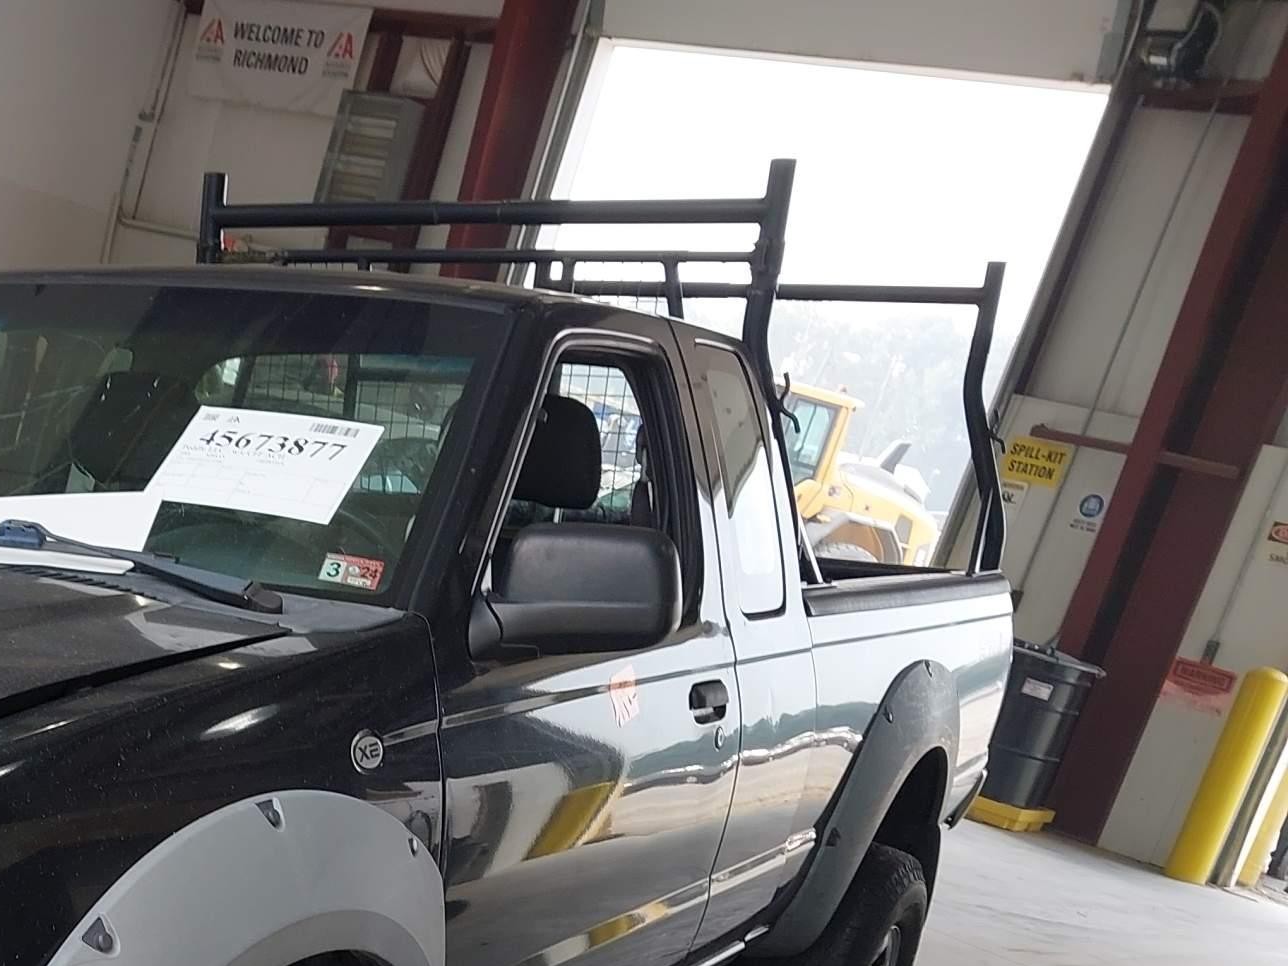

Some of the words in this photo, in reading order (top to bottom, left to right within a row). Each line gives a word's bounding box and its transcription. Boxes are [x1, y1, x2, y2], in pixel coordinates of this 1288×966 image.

[233, 20, 304, 47] WELCOME
[305, 28, 325, 49] TO
[233, 49, 309, 75] RICHMOND
[200, 429, 348, 461] 45673877
[1010, 442, 1067, 465] SPILL-KIT
[1008, 459, 1056, 480] STATION
[326, 562, 341, 578] 3
[360, 566, 378, 579] 24
[358, 742, 380, 762] XE
